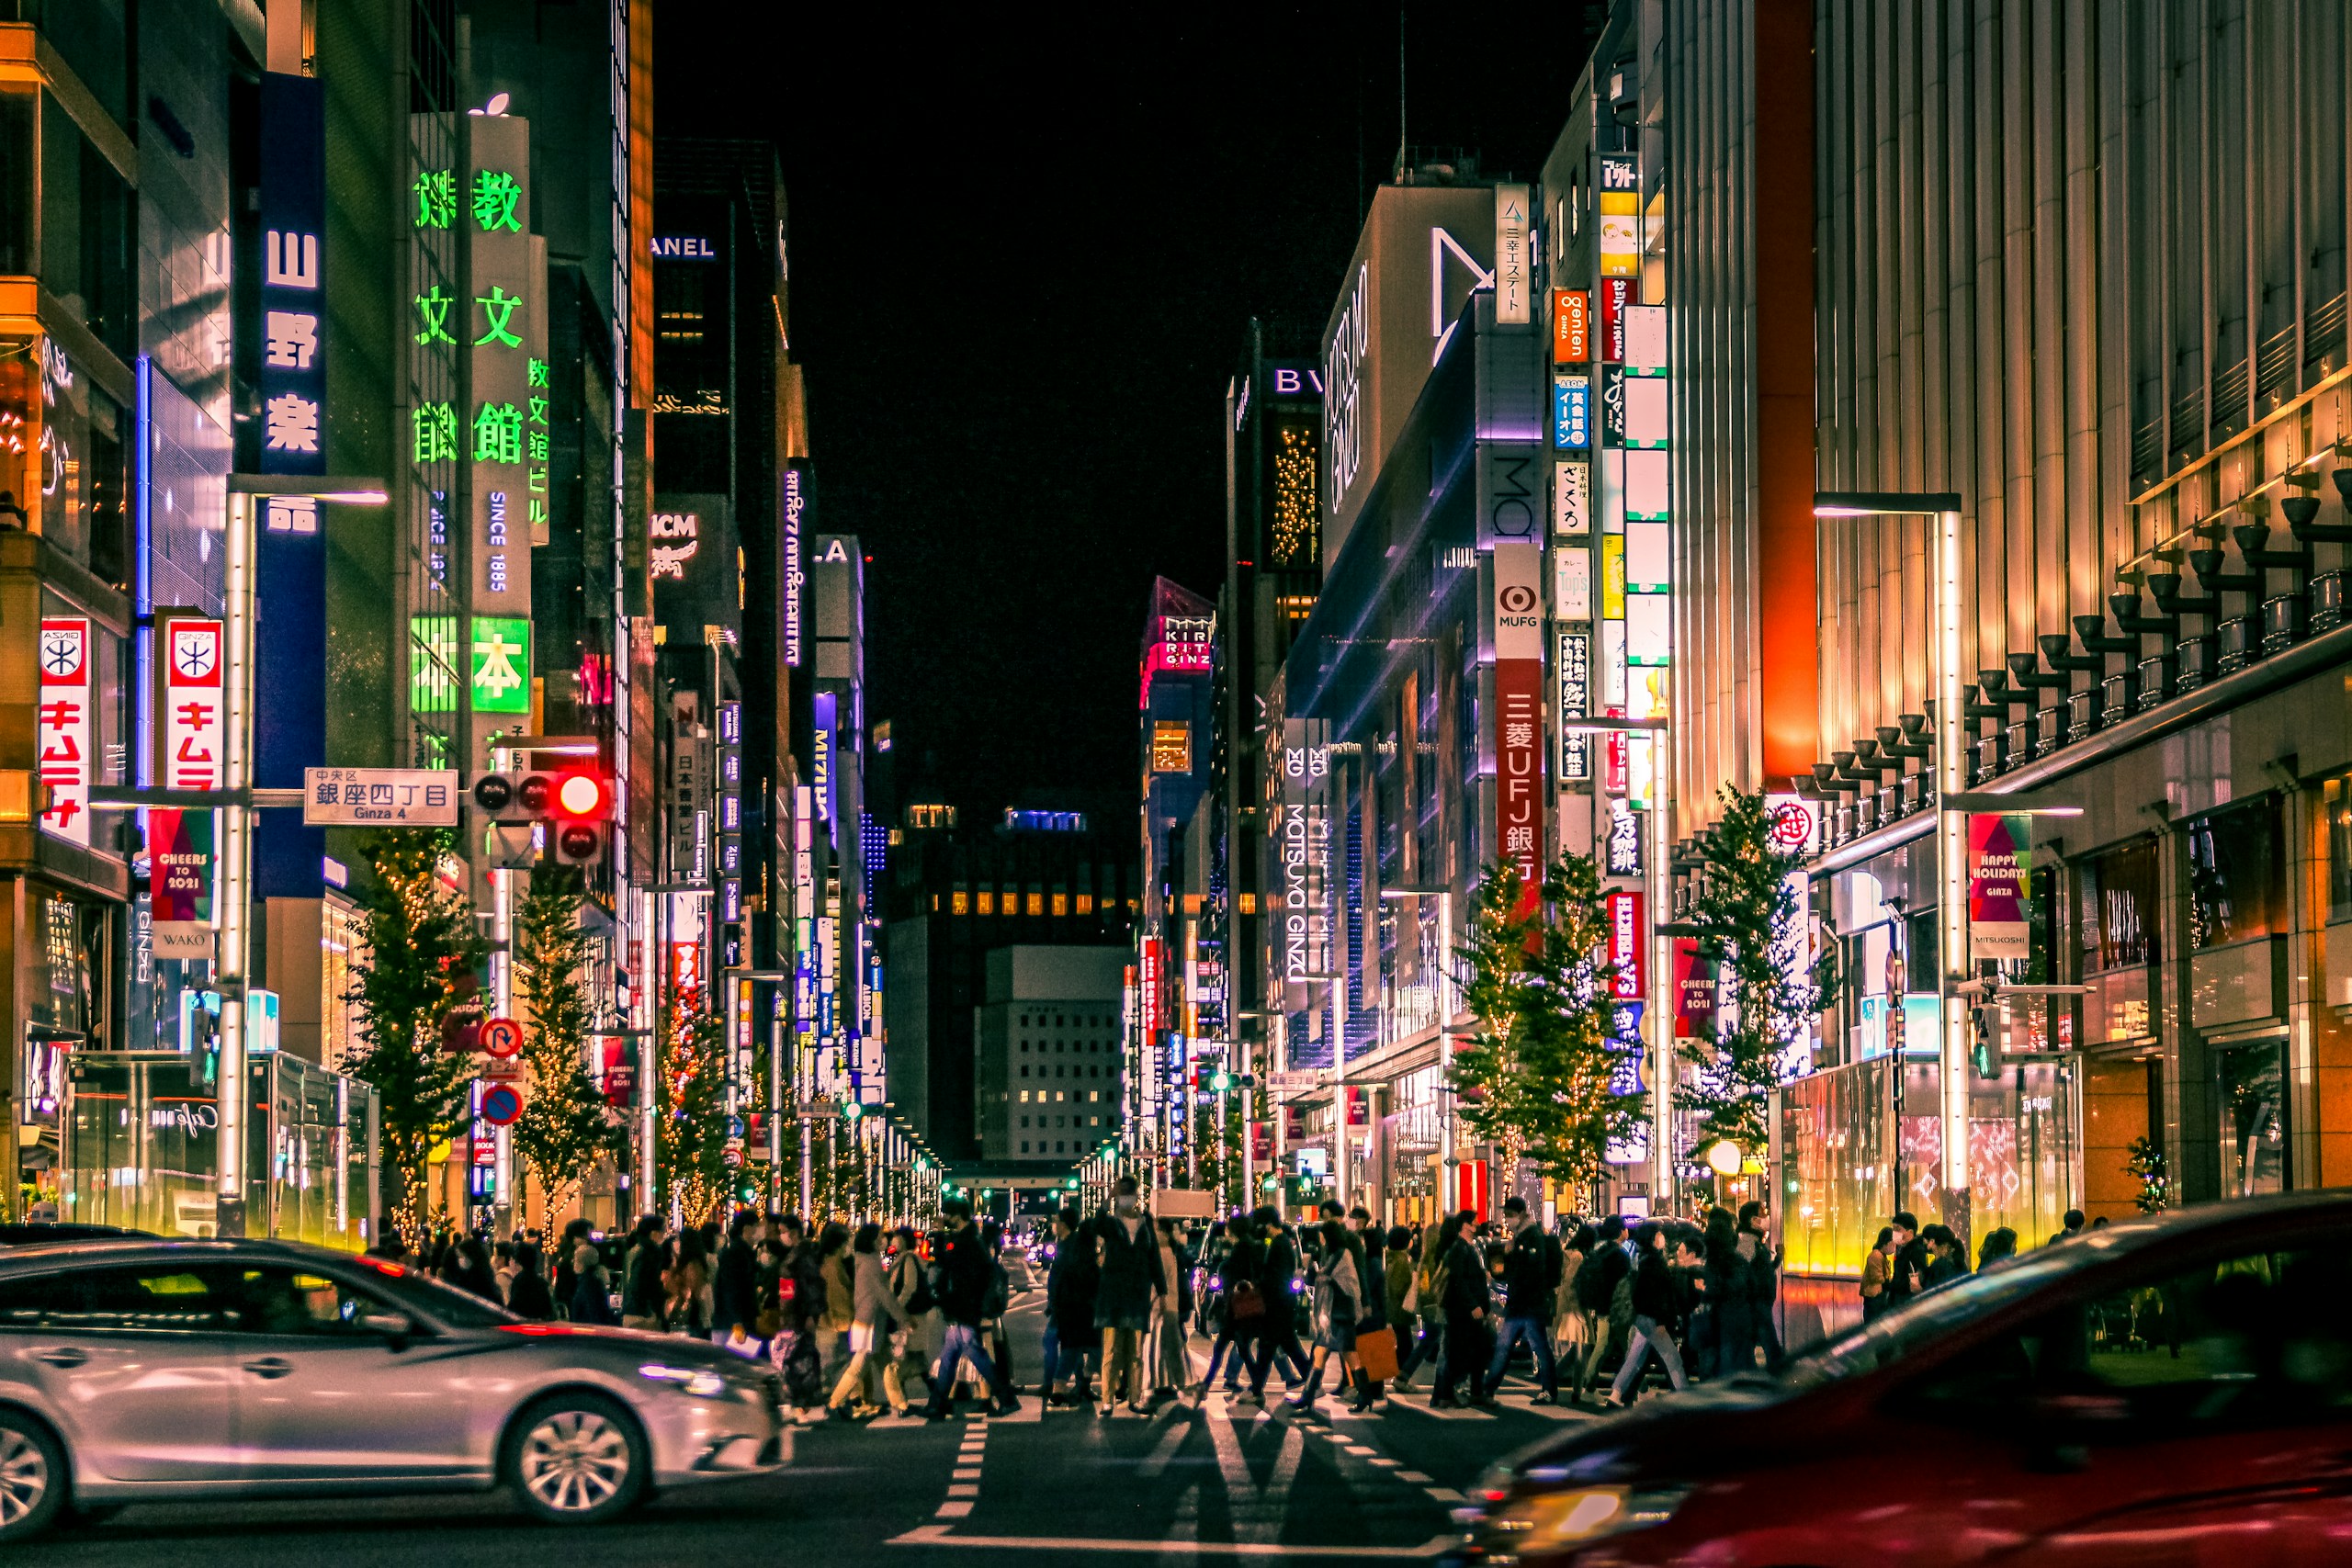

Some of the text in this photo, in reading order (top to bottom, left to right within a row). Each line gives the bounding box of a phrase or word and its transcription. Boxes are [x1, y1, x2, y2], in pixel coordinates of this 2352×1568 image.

[1506, 228, 1520, 310] 三幸エステート
[472, 168, 523, 464] 教文館
[1562, 296, 1584, 355] genten
[1571, 392, 1584, 430] 英会話
[1559, 392, 1570, 445] イーオン
[528, 356, 549, 525] 教文館ビル
[1573, 434, 1583, 442] 3F
[1578, 466, 1588, 499] 日本料理
[1563, 465, 1578, 527] ざくろ
[490, 491, 506, 593] SINCE 1885
[1499, 616, 1537, 626] MUFG
[473, 633, 523, 698] 本
[1562, 637, 1573, 682] 中国料理
[316, 770, 357, 782] 中央区
[316, 784, 447, 807] 銀座四丁目
[677, 755, 694, 852] 日本香堂ビル
[354, 807, 407, 820] Ginza 4
[159, 853, 208, 865] CHEERS
[1981, 855, 2018, 866] HAPPY
[175, 867, 190, 875] TO
[1632, 866, 1643, 876] 2F
[1973, 867, 2027, 879] HOLIDAYS
[168, 877, 199, 889] 2021
[1986, 887, 2013, 897] GINZA
[164, 933, 205, 946] WAKO
[1975, 936, 2025, 944] MITSUKOSHI
[1680, 979, 1716, 989] CHEERS
[862, 984, 871, 1021] ALBION
[1687, 998, 1711, 1009] 2021
